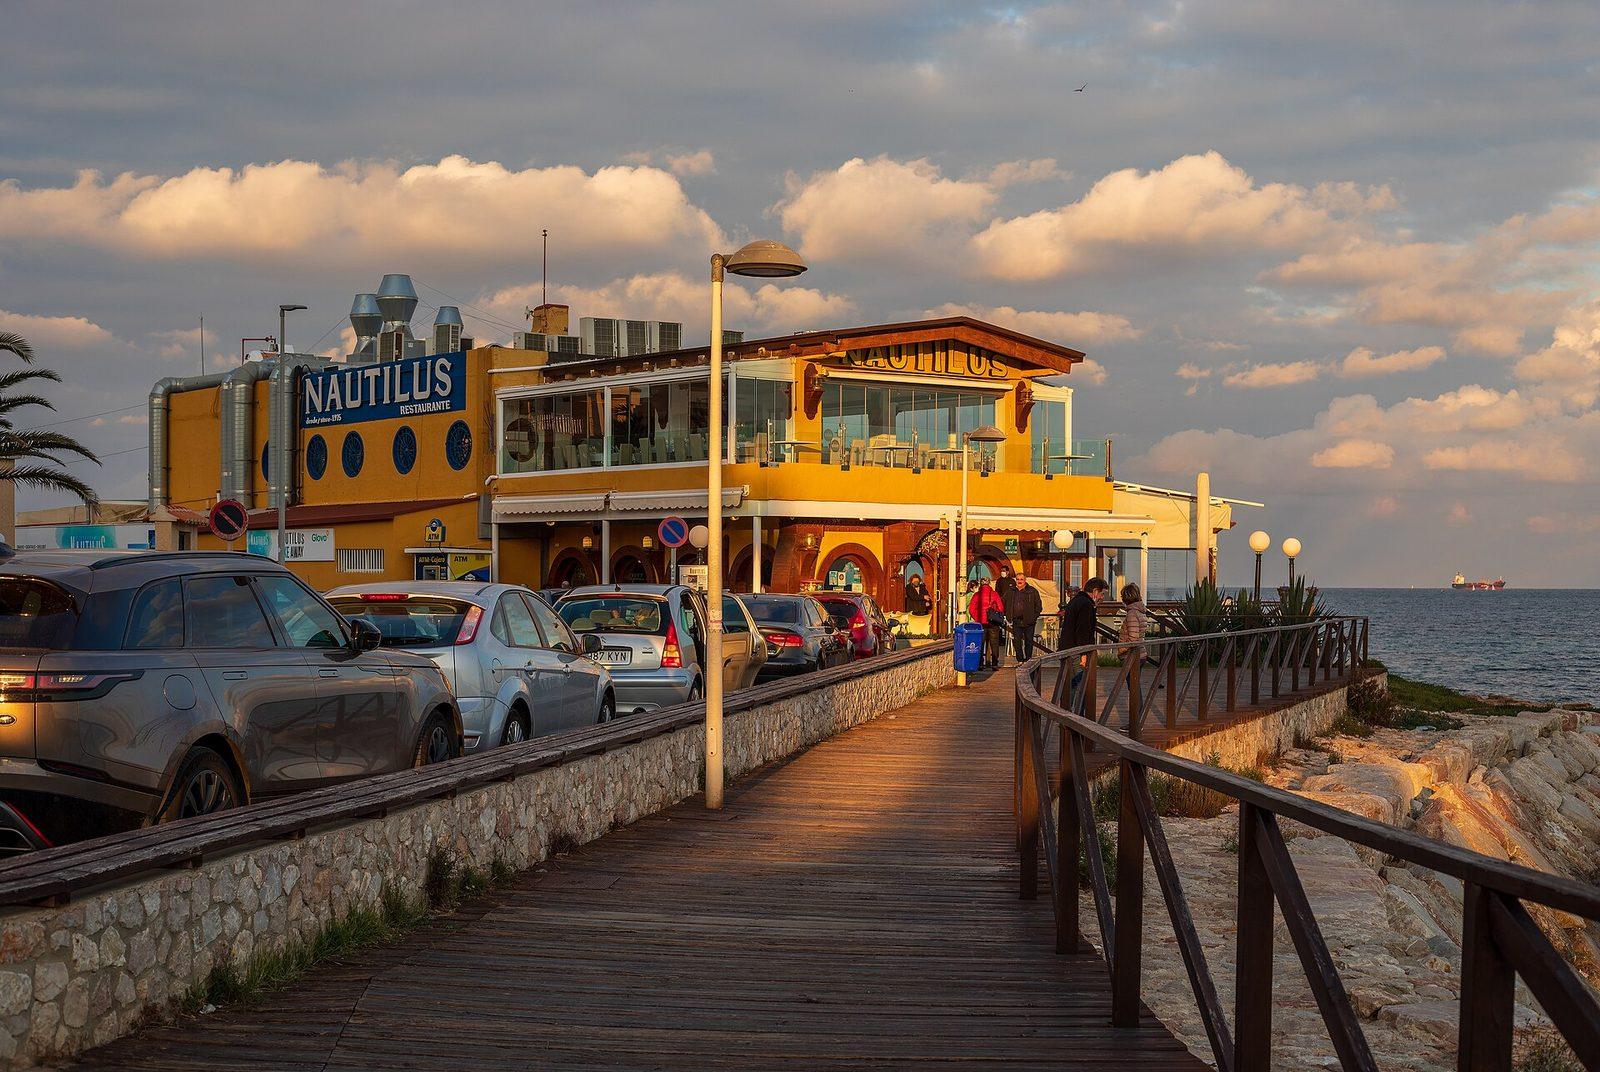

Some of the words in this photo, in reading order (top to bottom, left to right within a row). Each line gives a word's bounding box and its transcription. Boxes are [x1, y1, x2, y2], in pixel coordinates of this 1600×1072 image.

[843, 339, 1008, 378] NAUTILUS
[305, 357, 452, 415] NAUTILUS
[400, 400, 451, 415] RESTAURANTE
[285, 532, 305, 545] UTILUS
[311, 533, 328, 542] Glovo
[428, 533, 440, 541] ATM
[454, 555, 468, 563] ATM
[607, 652, 627, 661] KYN
